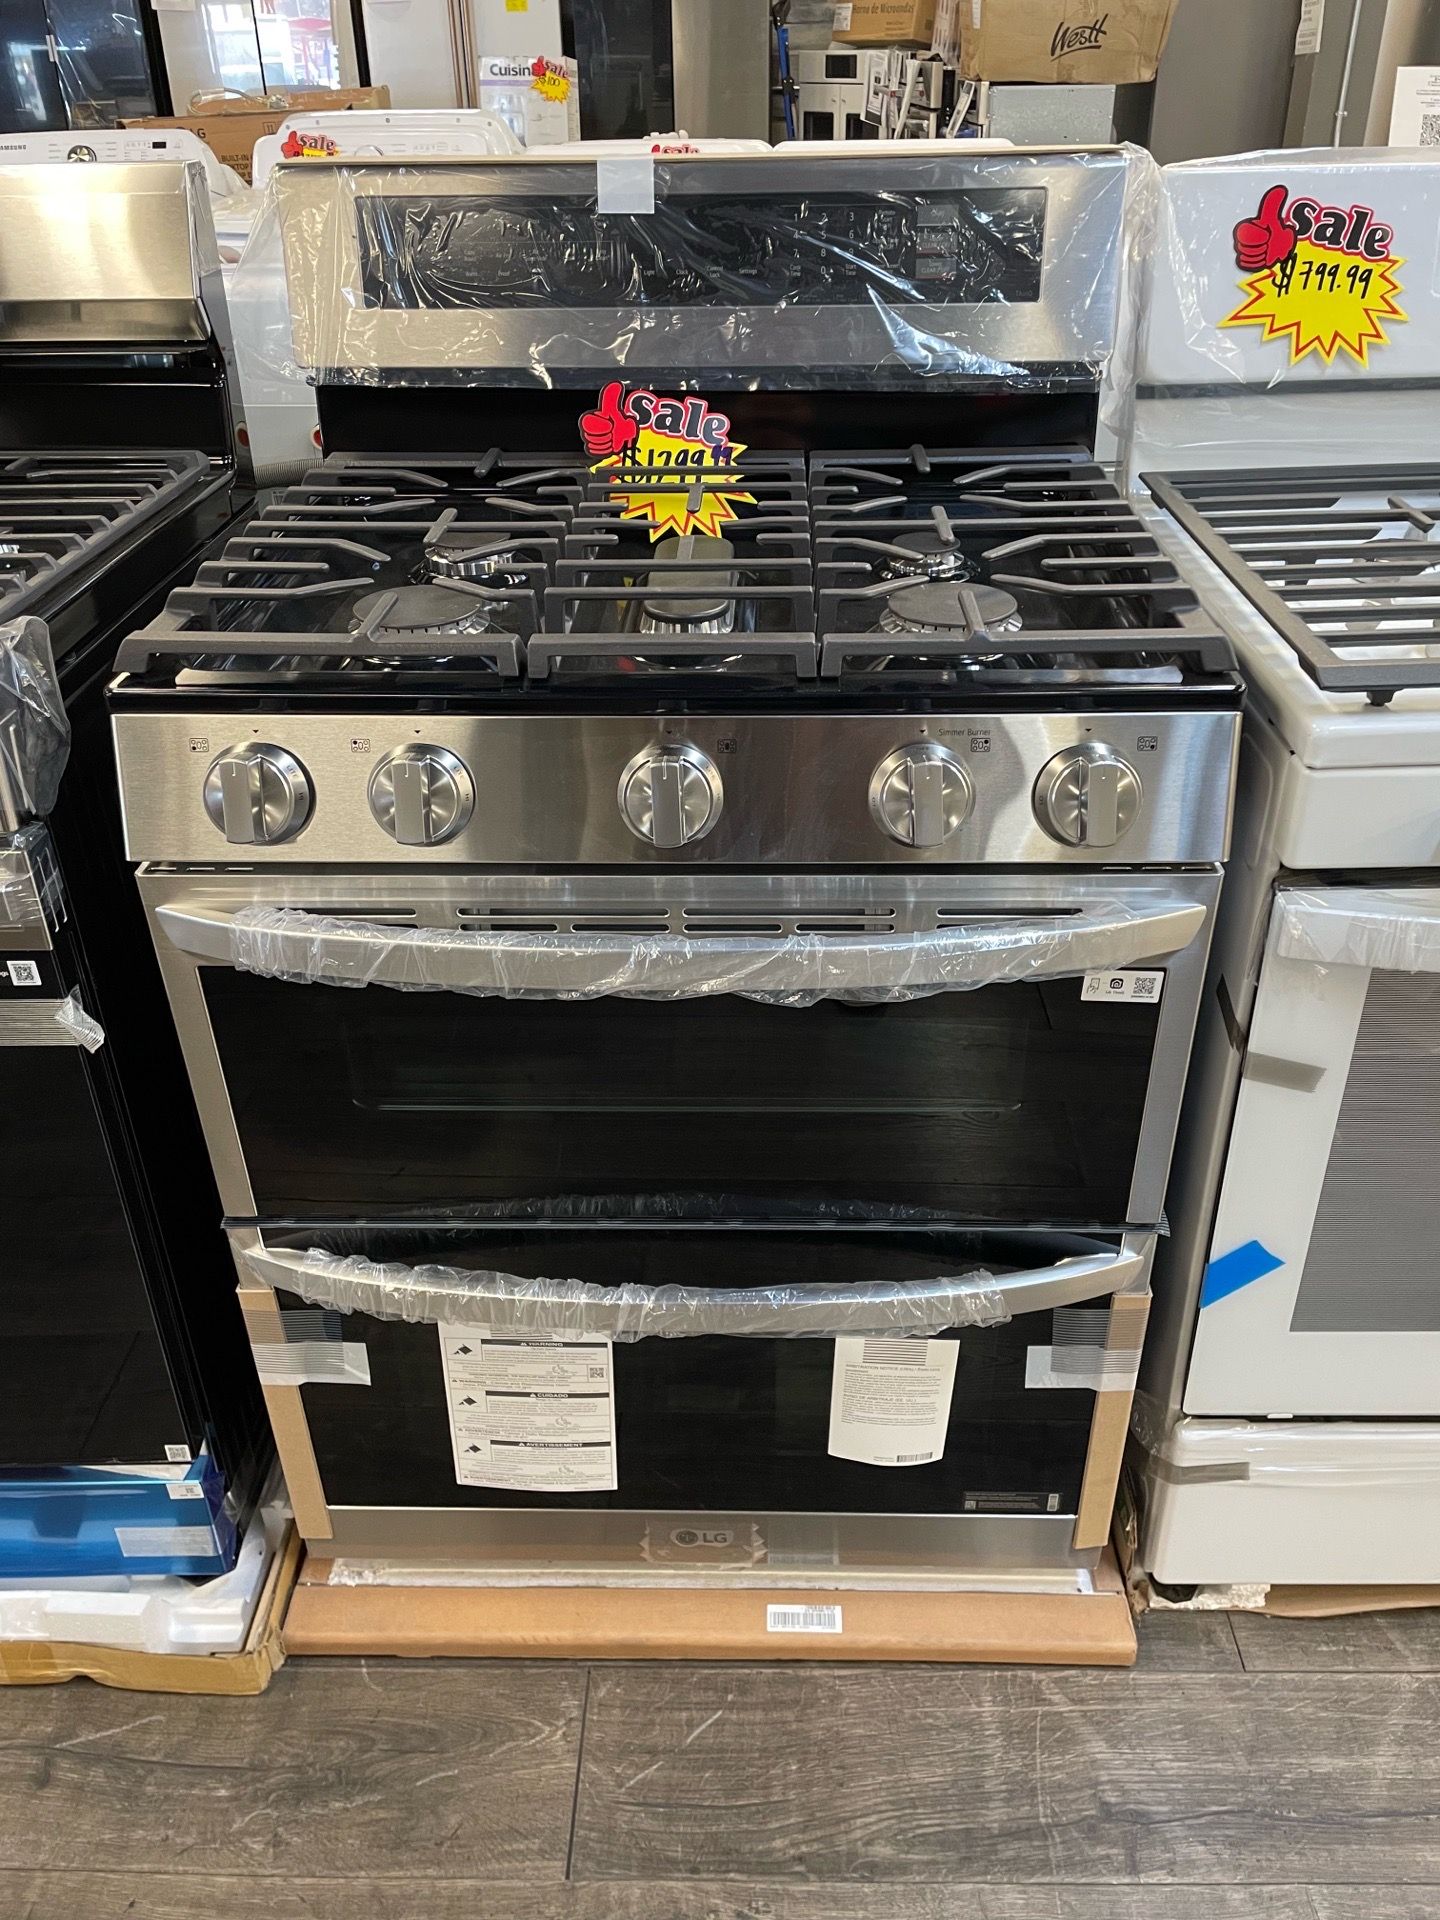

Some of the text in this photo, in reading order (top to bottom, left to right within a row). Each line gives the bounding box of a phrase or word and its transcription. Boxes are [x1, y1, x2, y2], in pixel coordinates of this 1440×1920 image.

[490, 64, 531, 77] Cuisin
[1271, 252, 1374, 299] $799.99
[938, 728, 991, 736] Simmer Burner
[702, 1532, 728, 1544] LG
